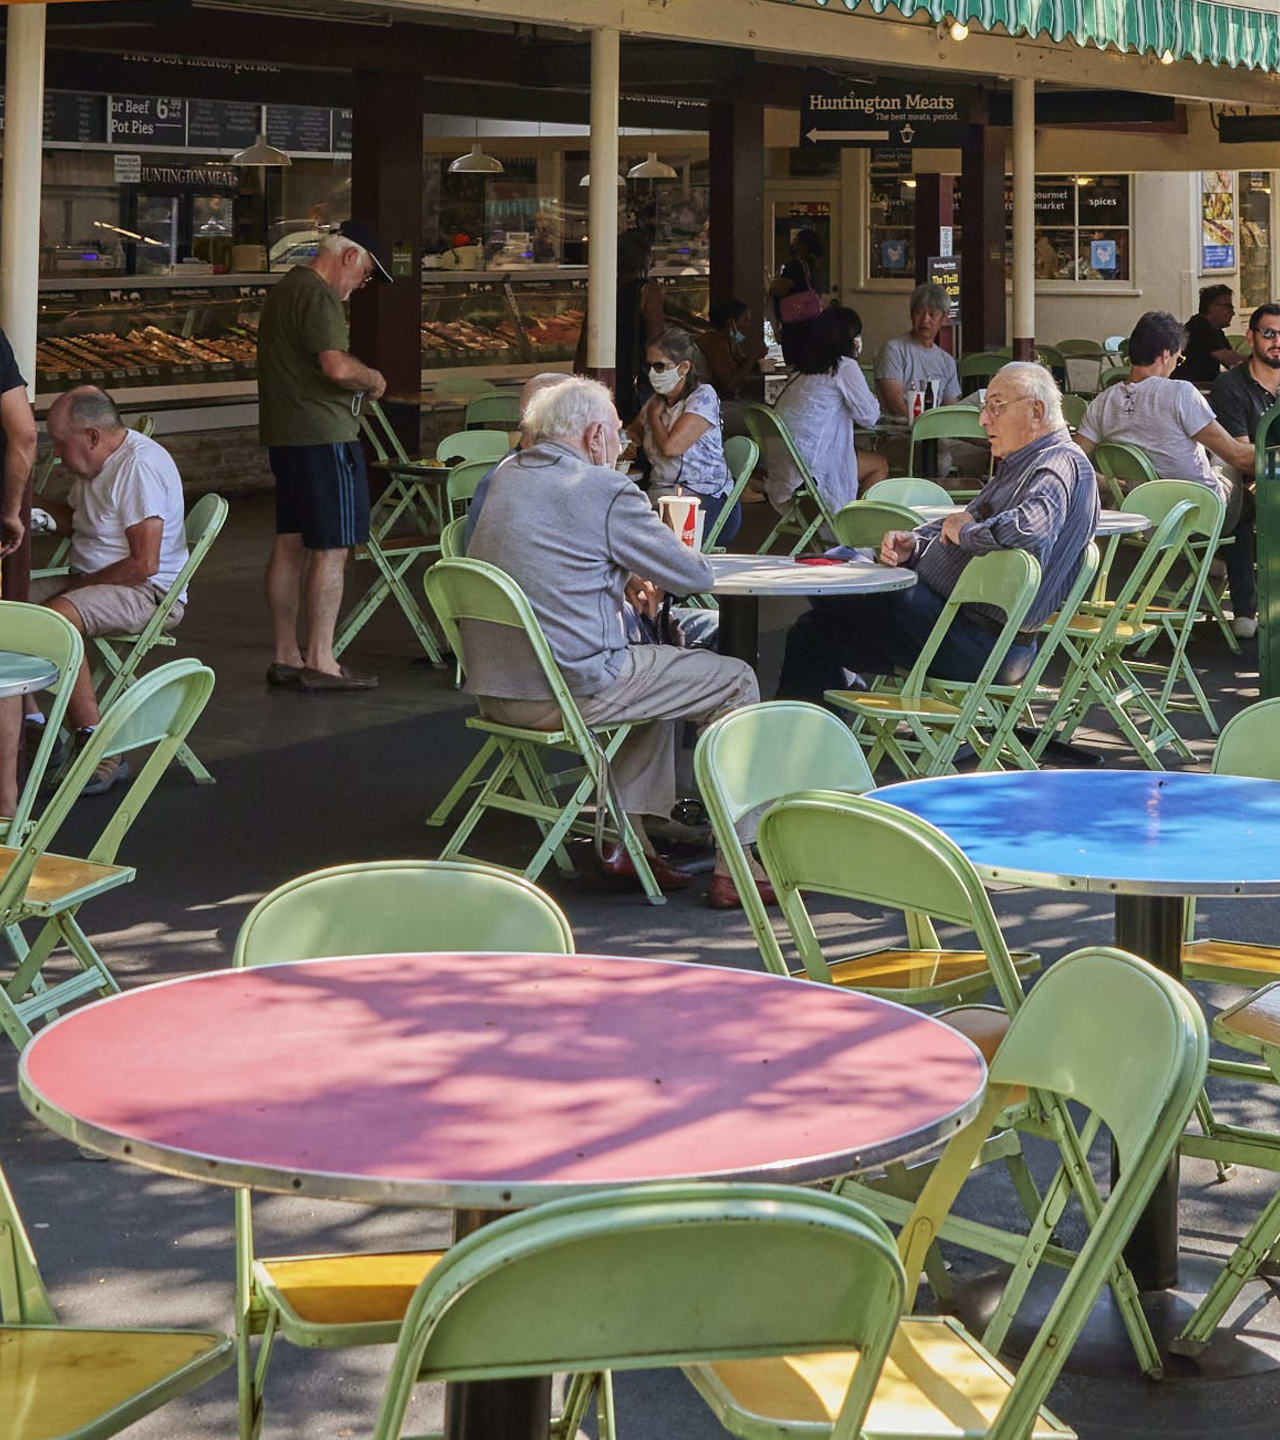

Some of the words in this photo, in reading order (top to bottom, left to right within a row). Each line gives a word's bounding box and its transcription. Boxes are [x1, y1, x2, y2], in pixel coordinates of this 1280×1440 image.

[125, 99, 151, 115] Beef
[810, 92, 901, 113] Huntington
[905, 94, 955, 110] Meats
[112, 119, 131, 134] Pot
[132, 120, 154, 135] Pies
[1034, 190, 1068, 201] ourmet
[1089, 197, 1117, 208] spices
